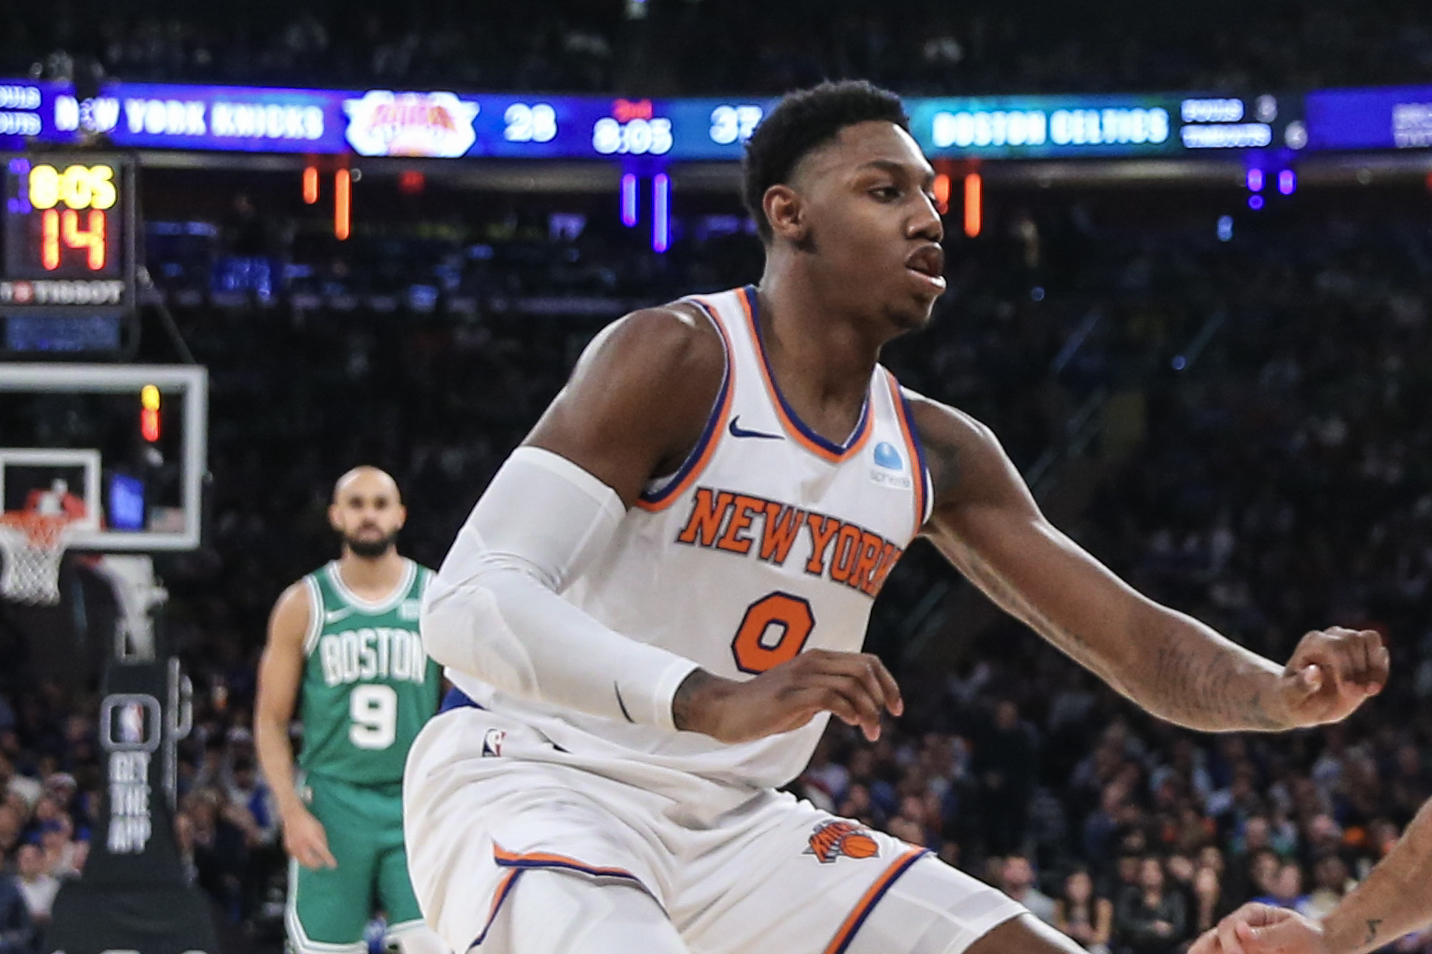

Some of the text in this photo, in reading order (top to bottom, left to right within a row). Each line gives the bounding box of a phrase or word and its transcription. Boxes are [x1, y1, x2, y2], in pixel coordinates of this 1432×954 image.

[709, 105, 763, 145] 37
[29, 164, 117, 210] 8:05
[42, 208, 106, 271] 14
[674, 486, 904, 600] NEW YORK
[319, 627, 428, 688] BOSTON
[731, 590, 816, 675] 0
[349, 683, 398, 750] 9
